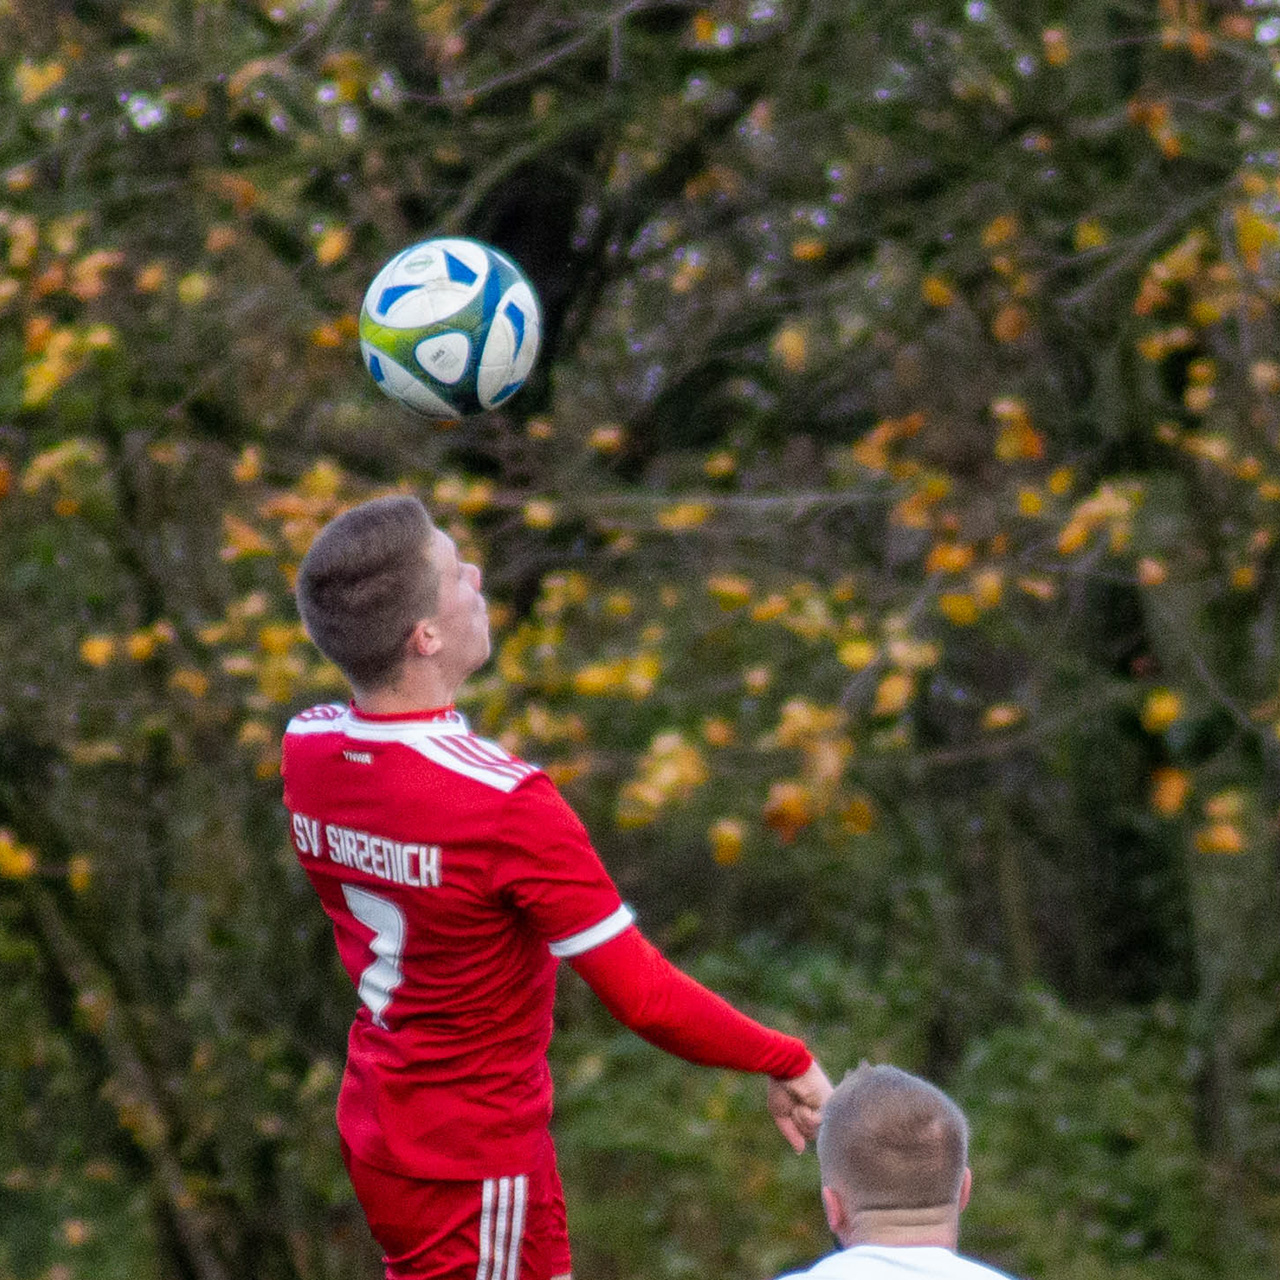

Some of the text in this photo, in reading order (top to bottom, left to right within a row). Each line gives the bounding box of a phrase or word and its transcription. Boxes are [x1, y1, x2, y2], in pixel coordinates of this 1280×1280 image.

[292, 812, 441, 888] SV SIRZENICH
[340, 883, 407, 1031] 7
